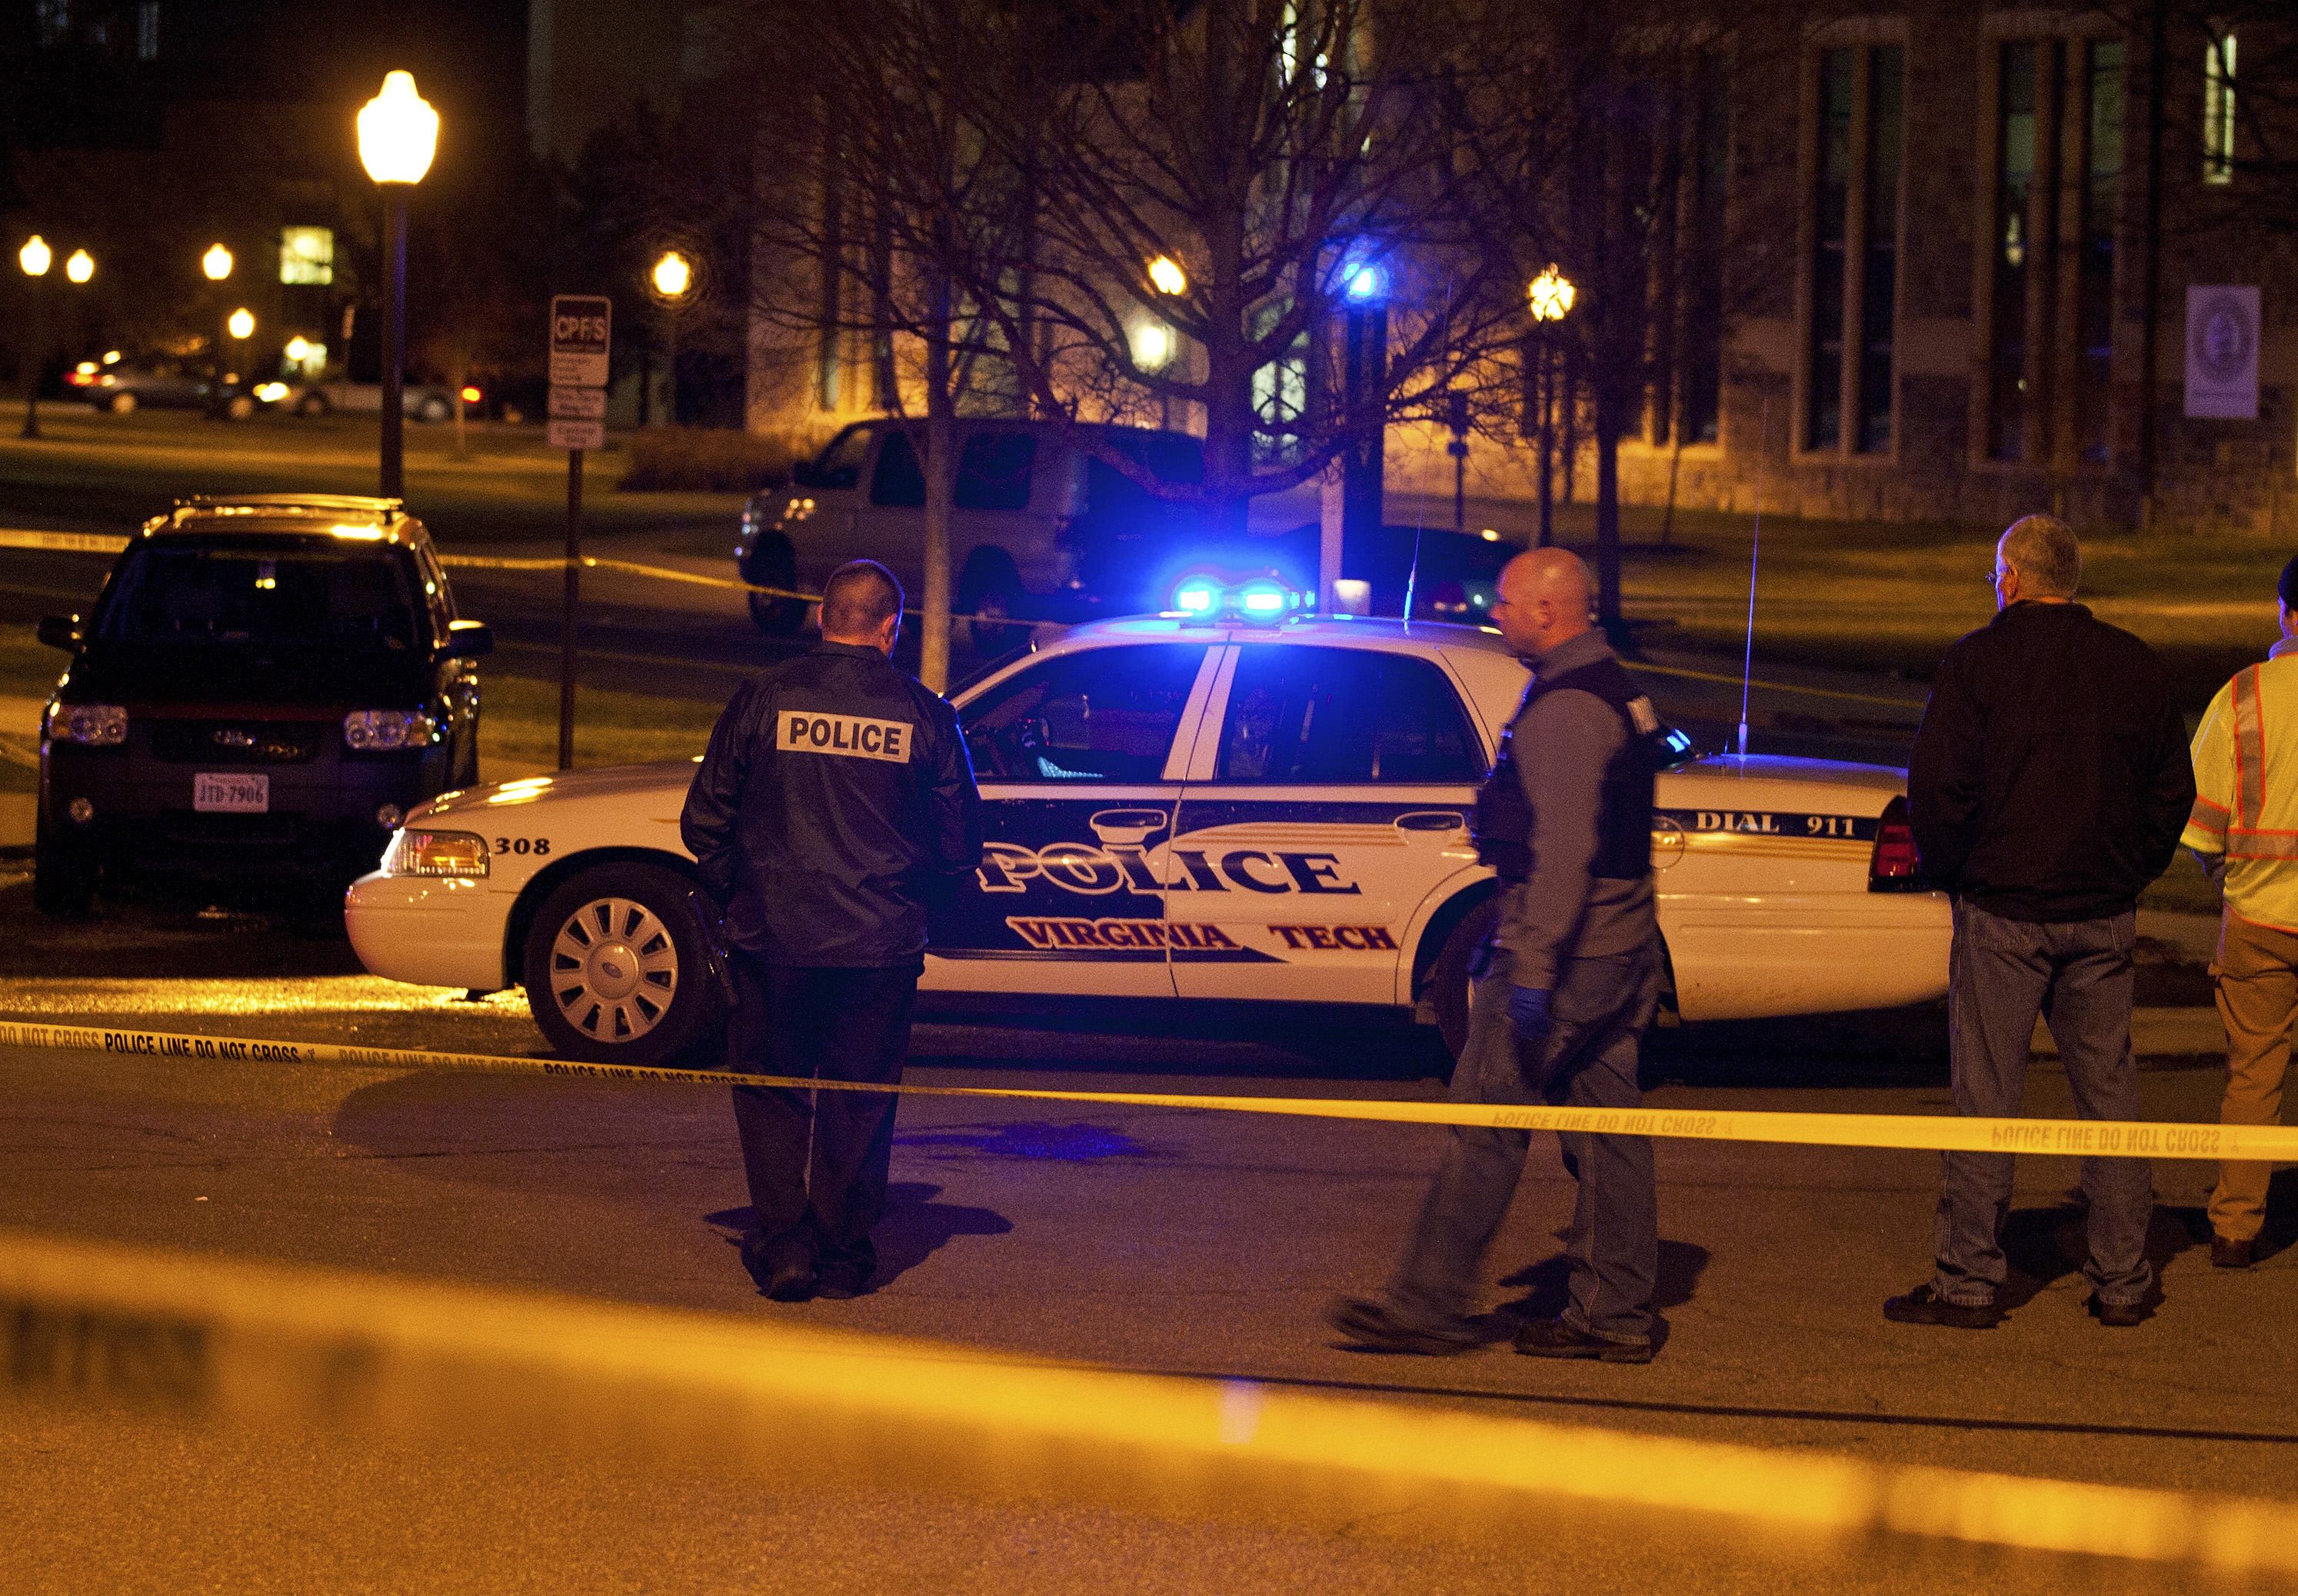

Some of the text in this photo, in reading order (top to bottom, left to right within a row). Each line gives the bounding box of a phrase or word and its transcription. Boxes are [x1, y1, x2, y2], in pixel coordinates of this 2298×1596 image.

[790, 717, 901, 755] POLICE
[1697, 811, 1855, 837] DIAL 911
[495, 838, 551, 855] 308
[978, 842, 1361, 895] POLICE
[1005, 916, 1399, 951] VIRGINIA TECH
[105, 1033, 301, 1063] POLICE LINE DO NOT CROSS
